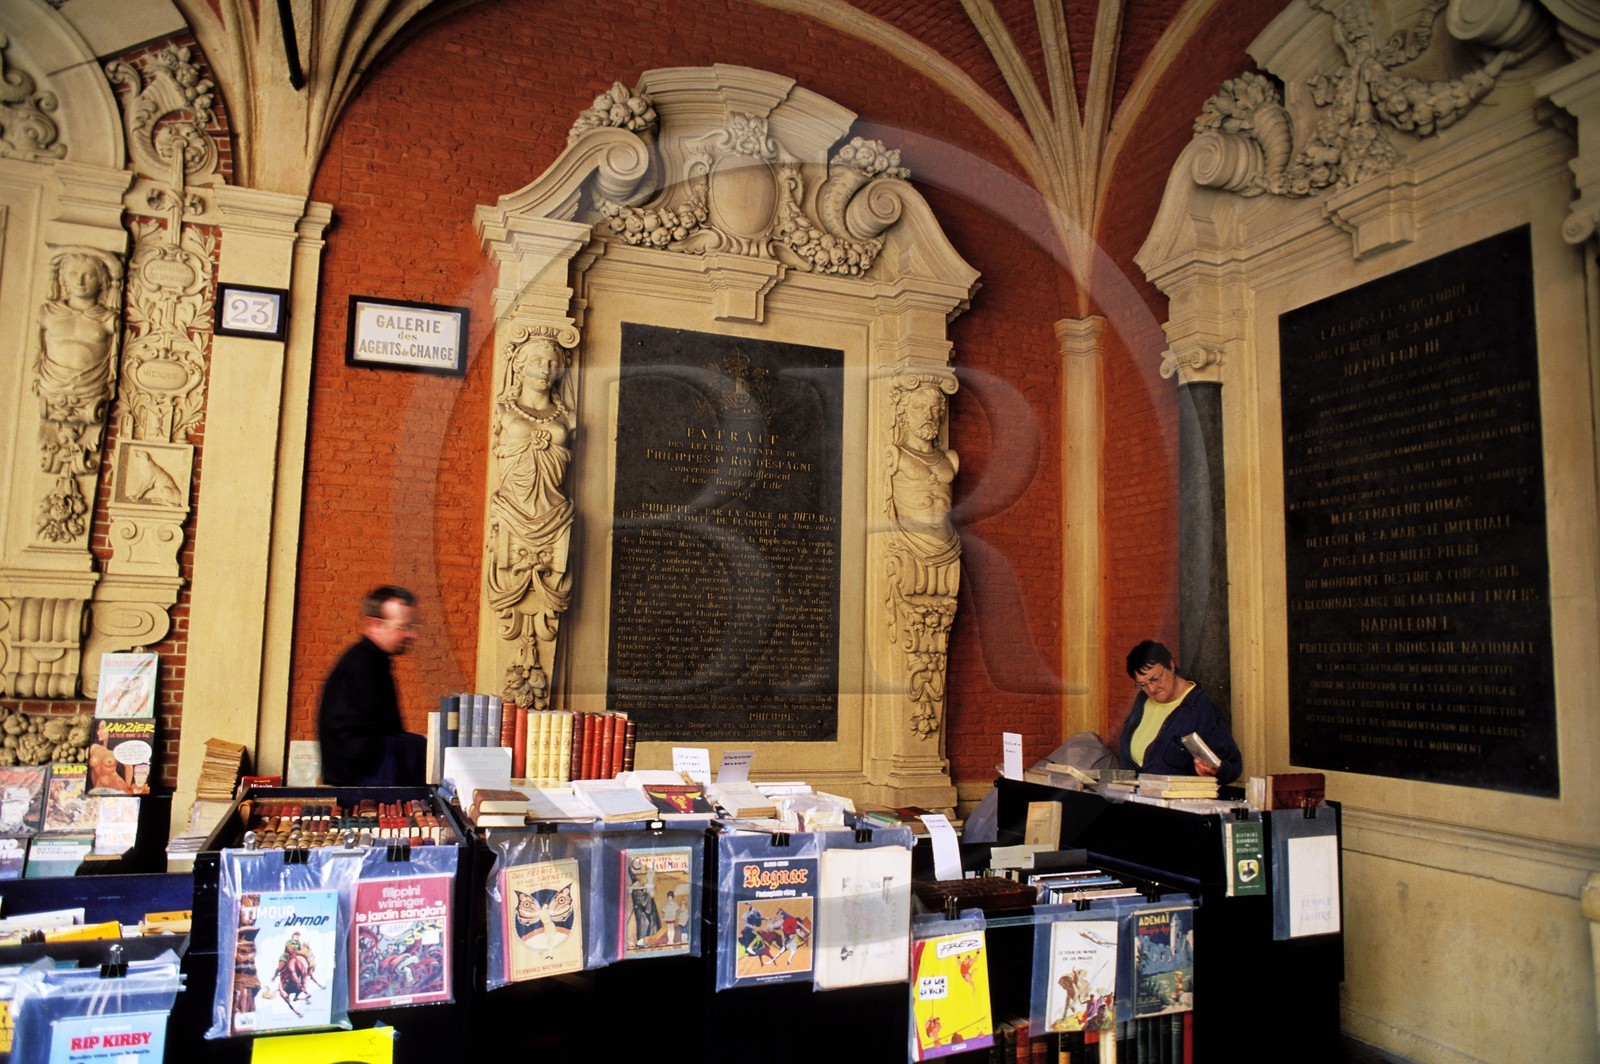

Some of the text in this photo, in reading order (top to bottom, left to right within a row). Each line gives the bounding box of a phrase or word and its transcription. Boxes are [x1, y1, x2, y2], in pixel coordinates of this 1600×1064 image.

[231, 299, 270, 325] 23
[376, 314, 441, 334] GALERIE
[397, 331, 418, 341] des
[358, 339, 454, 361] AGENTS de CHANGE
[1425, 337, 1440, 355] III
[668, 439, 684, 449] DES
[686, 426, 780, 447] EXTRAIT
[646, 447, 711, 464] PHILIPPES
[731, 454, 753, 468] ROY
[669, 463, 720, 475] concernant
[761, 480, 784, 491] Lille
[1425, 495, 1473, 513] DUMAS
[705, 508, 723, 517] PAR
[728, 509, 740, 518] LA
[778, 512, 789, 522] DE
[716, 517, 728, 525] DE
[1321, 574, 1380, 590] MONUMENT
[1305, 595, 1390, 611] RECONNAISSANCE
[1429, 590, 1476, 605] FRANCE
[1484, 588, 1540, 604] ENVERS
[1299, 642, 1363, 655] PROTECTEUR
[1461, 640, 1536, 656] NATIONALE
[1446, 703, 1527, 718] CONSTRUCTION
[104, 720, 156, 734] LAUZIER
[1458, 723, 1477, 735] DES
[1479, 725, 1527, 738] GALERIES
[1413, 738, 1426, 750] LE
[1428, 739, 1484, 755] MONUMENT
[742, 864, 809, 890] Ragnar
[382, 884, 421, 899] filippini
[378, 896, 425, 909] wininger
[241, 904, 295, 921] TIMOUR
[355, 904, 447, 923] le jardin sanglant
[71, 1031, 152, 1051] RIP KIRBY
